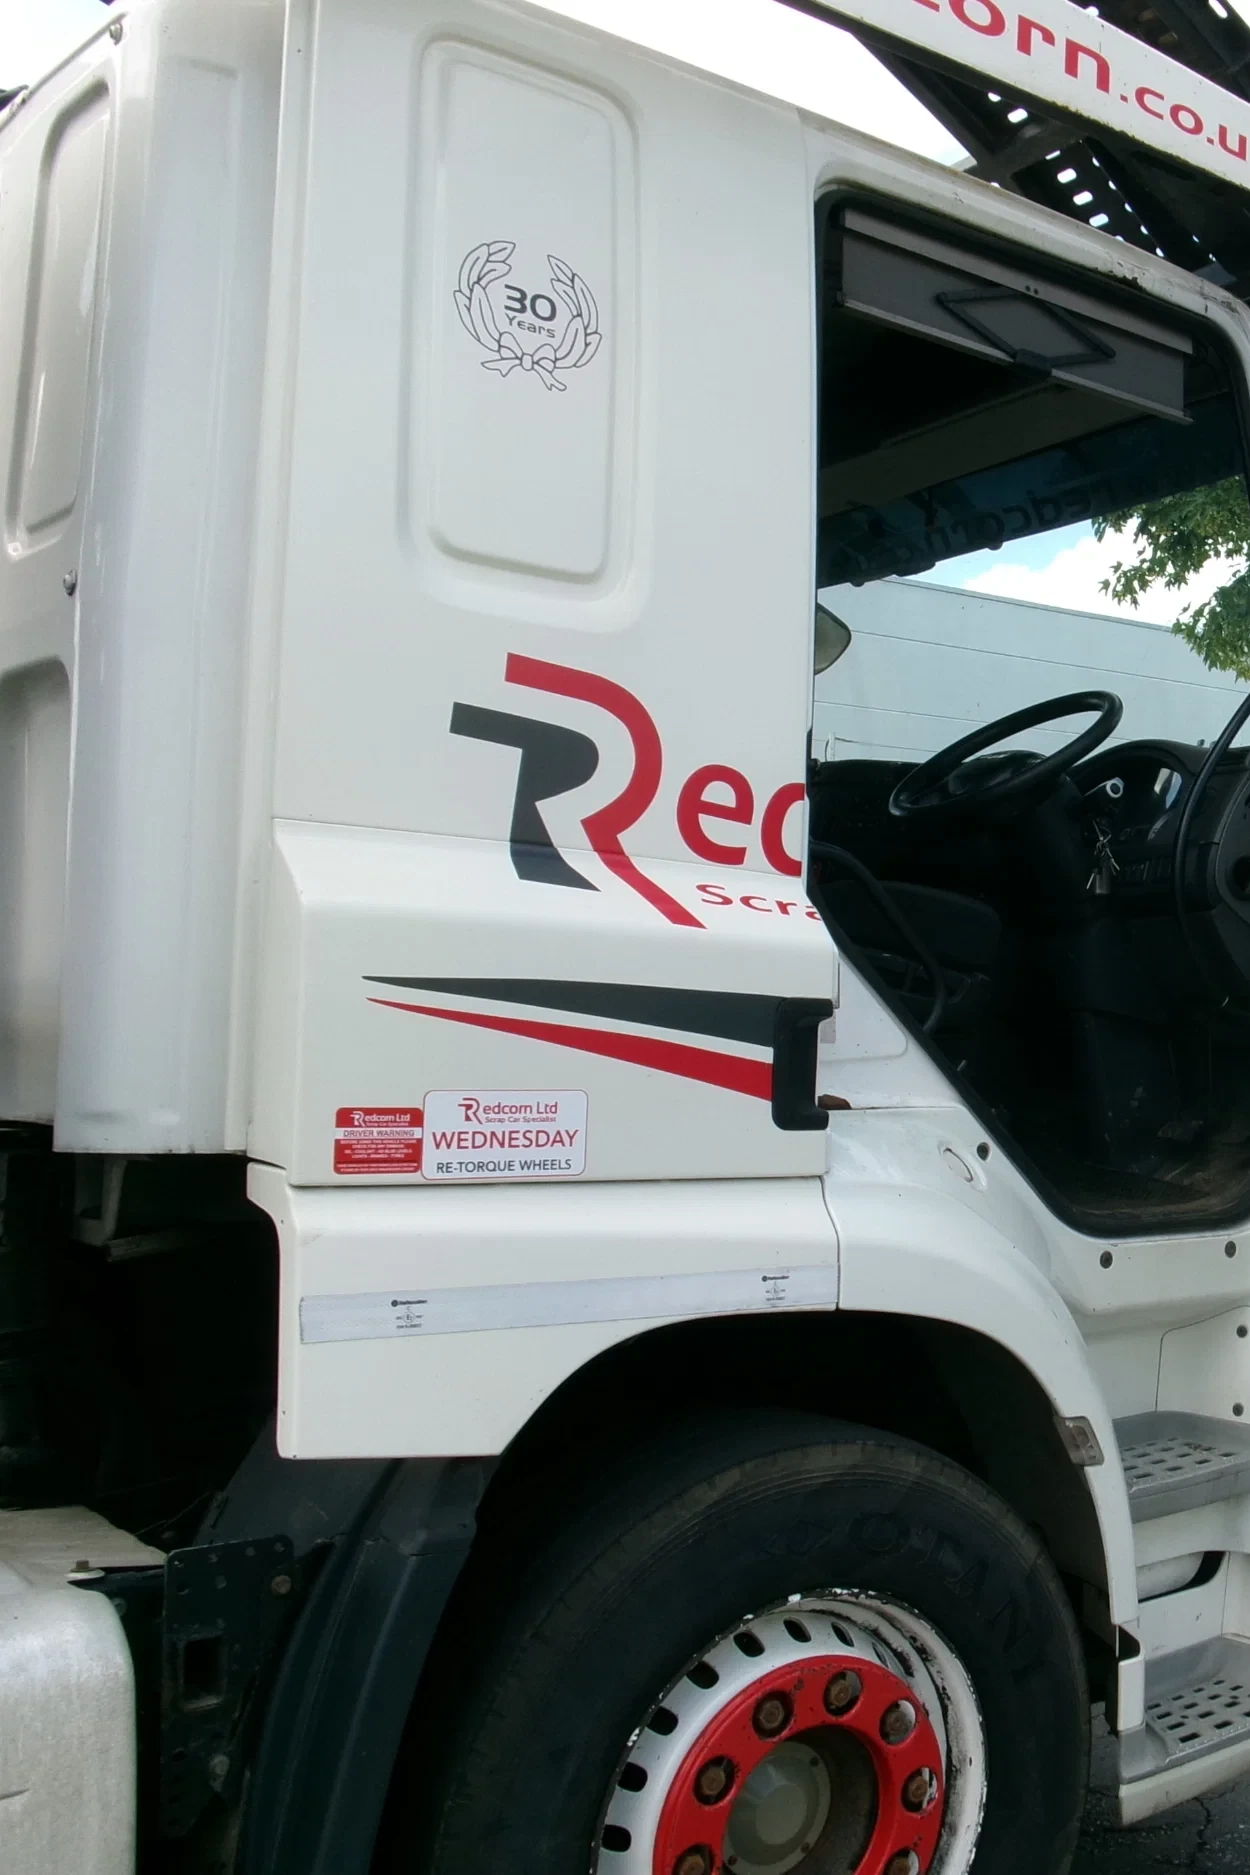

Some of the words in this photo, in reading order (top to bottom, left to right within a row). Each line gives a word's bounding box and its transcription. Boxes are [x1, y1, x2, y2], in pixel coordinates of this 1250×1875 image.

[504, 283, 557, 322] 30
[504, 313, 556, 339] Years
[458, 1097, 533, 1124] Redcorn
[536, 1101, 558, 1114] Ltd
[484, 1116, 505, 1124] Scrap
[522, 1115, 557, 1123] Specialist
[343, 1129, 374, 1137] DRIVER
[376, 1129, 415, 1137] WARNING
[432, 1129, 579, 1150] WEDNESDAY
[436, 1160, 516, 1174] RE-TORQUE
[518, 1158, 572, 1171] WHEELS
